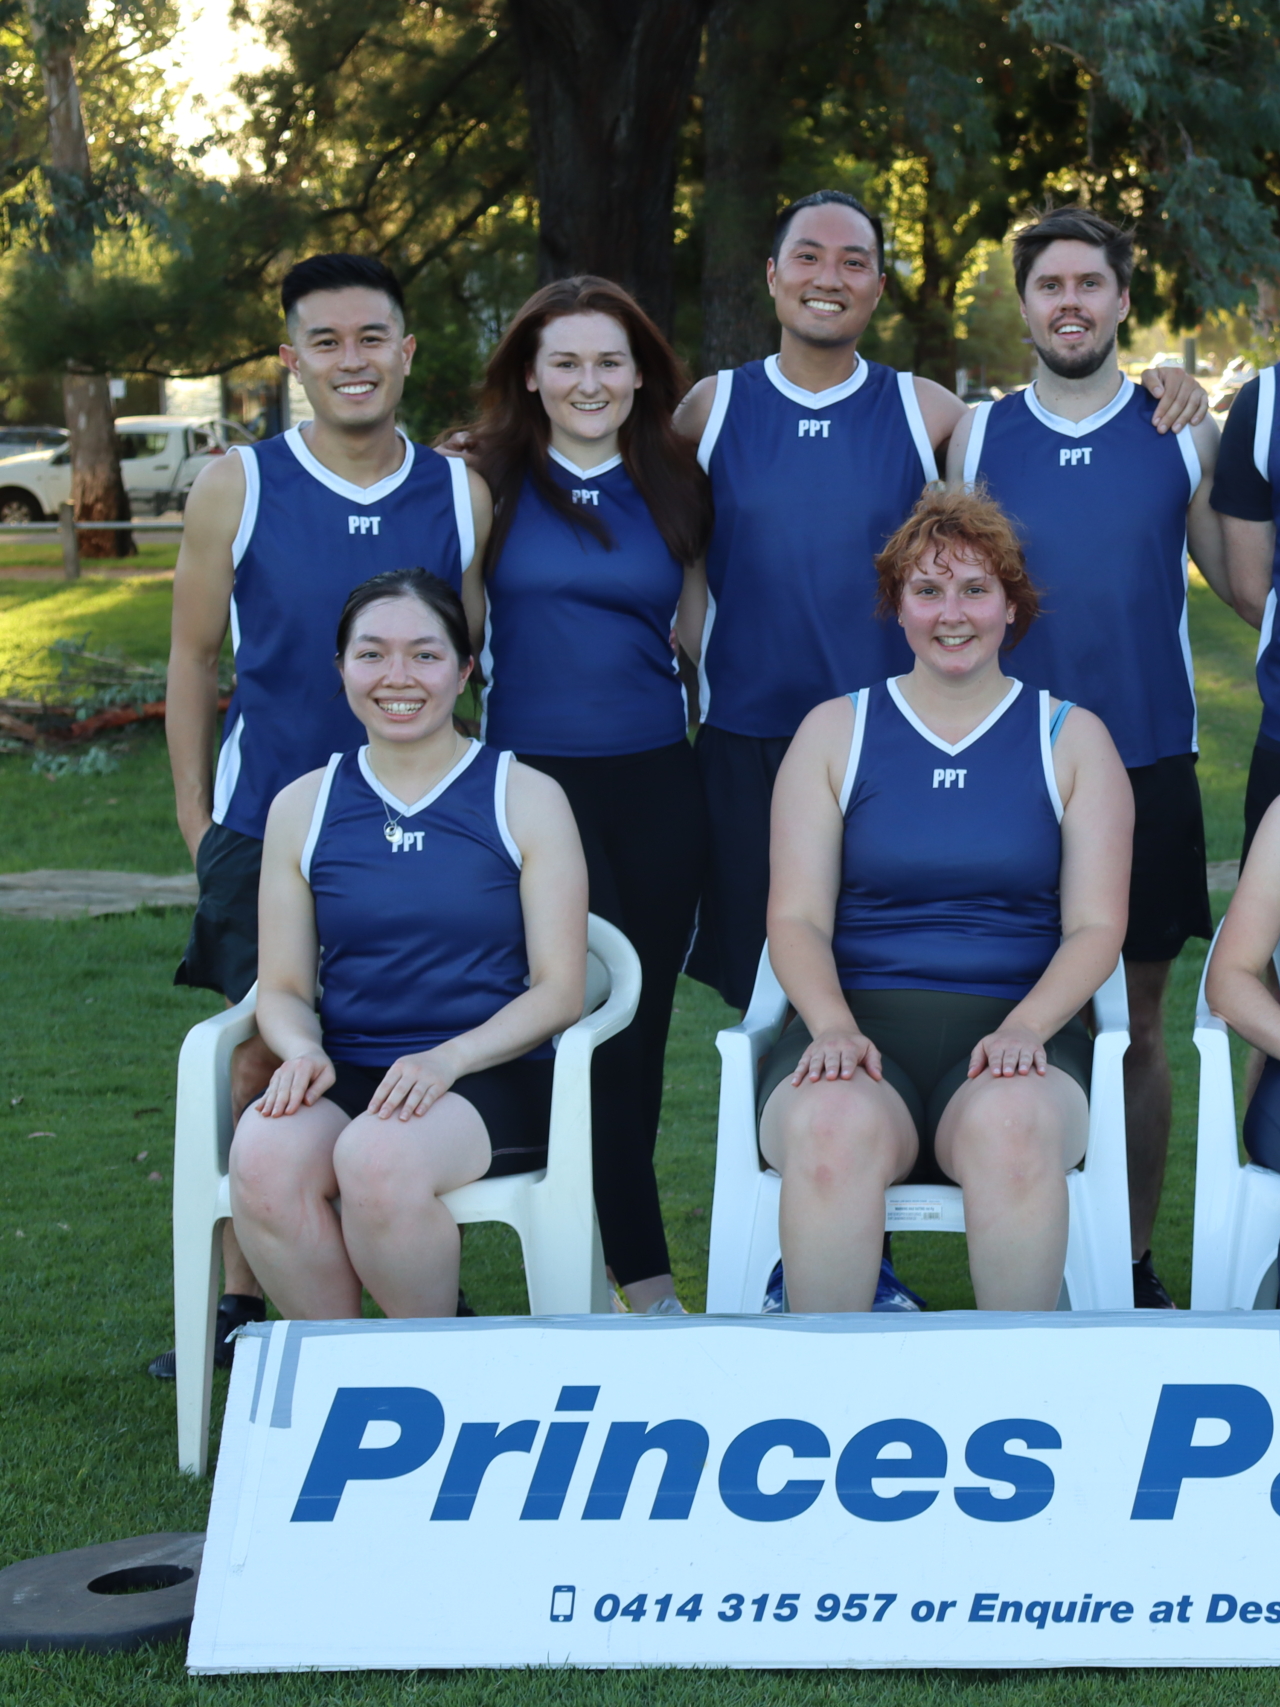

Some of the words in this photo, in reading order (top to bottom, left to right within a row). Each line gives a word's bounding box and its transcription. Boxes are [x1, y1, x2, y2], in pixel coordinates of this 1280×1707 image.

[797, 418, 832, 439] PPT
[1059, 446, 1093, 467] PPT
[572, 489, 599, 506] PPT
[347, 515, 382, 536] PPT
[932, 768, 968, 789] PPT
[290, 1385, 1063, 1523] Princes
[593, 1593, 704, 1623] 0414
[717, 1593, 801, 1623] 315
[814, 1593, 898, 1623] 957
[910, 1600, 958, 1623] or
[967, 1592, 1134, 1630] Enquire
[1148, 1595, 1194, 1624] at
